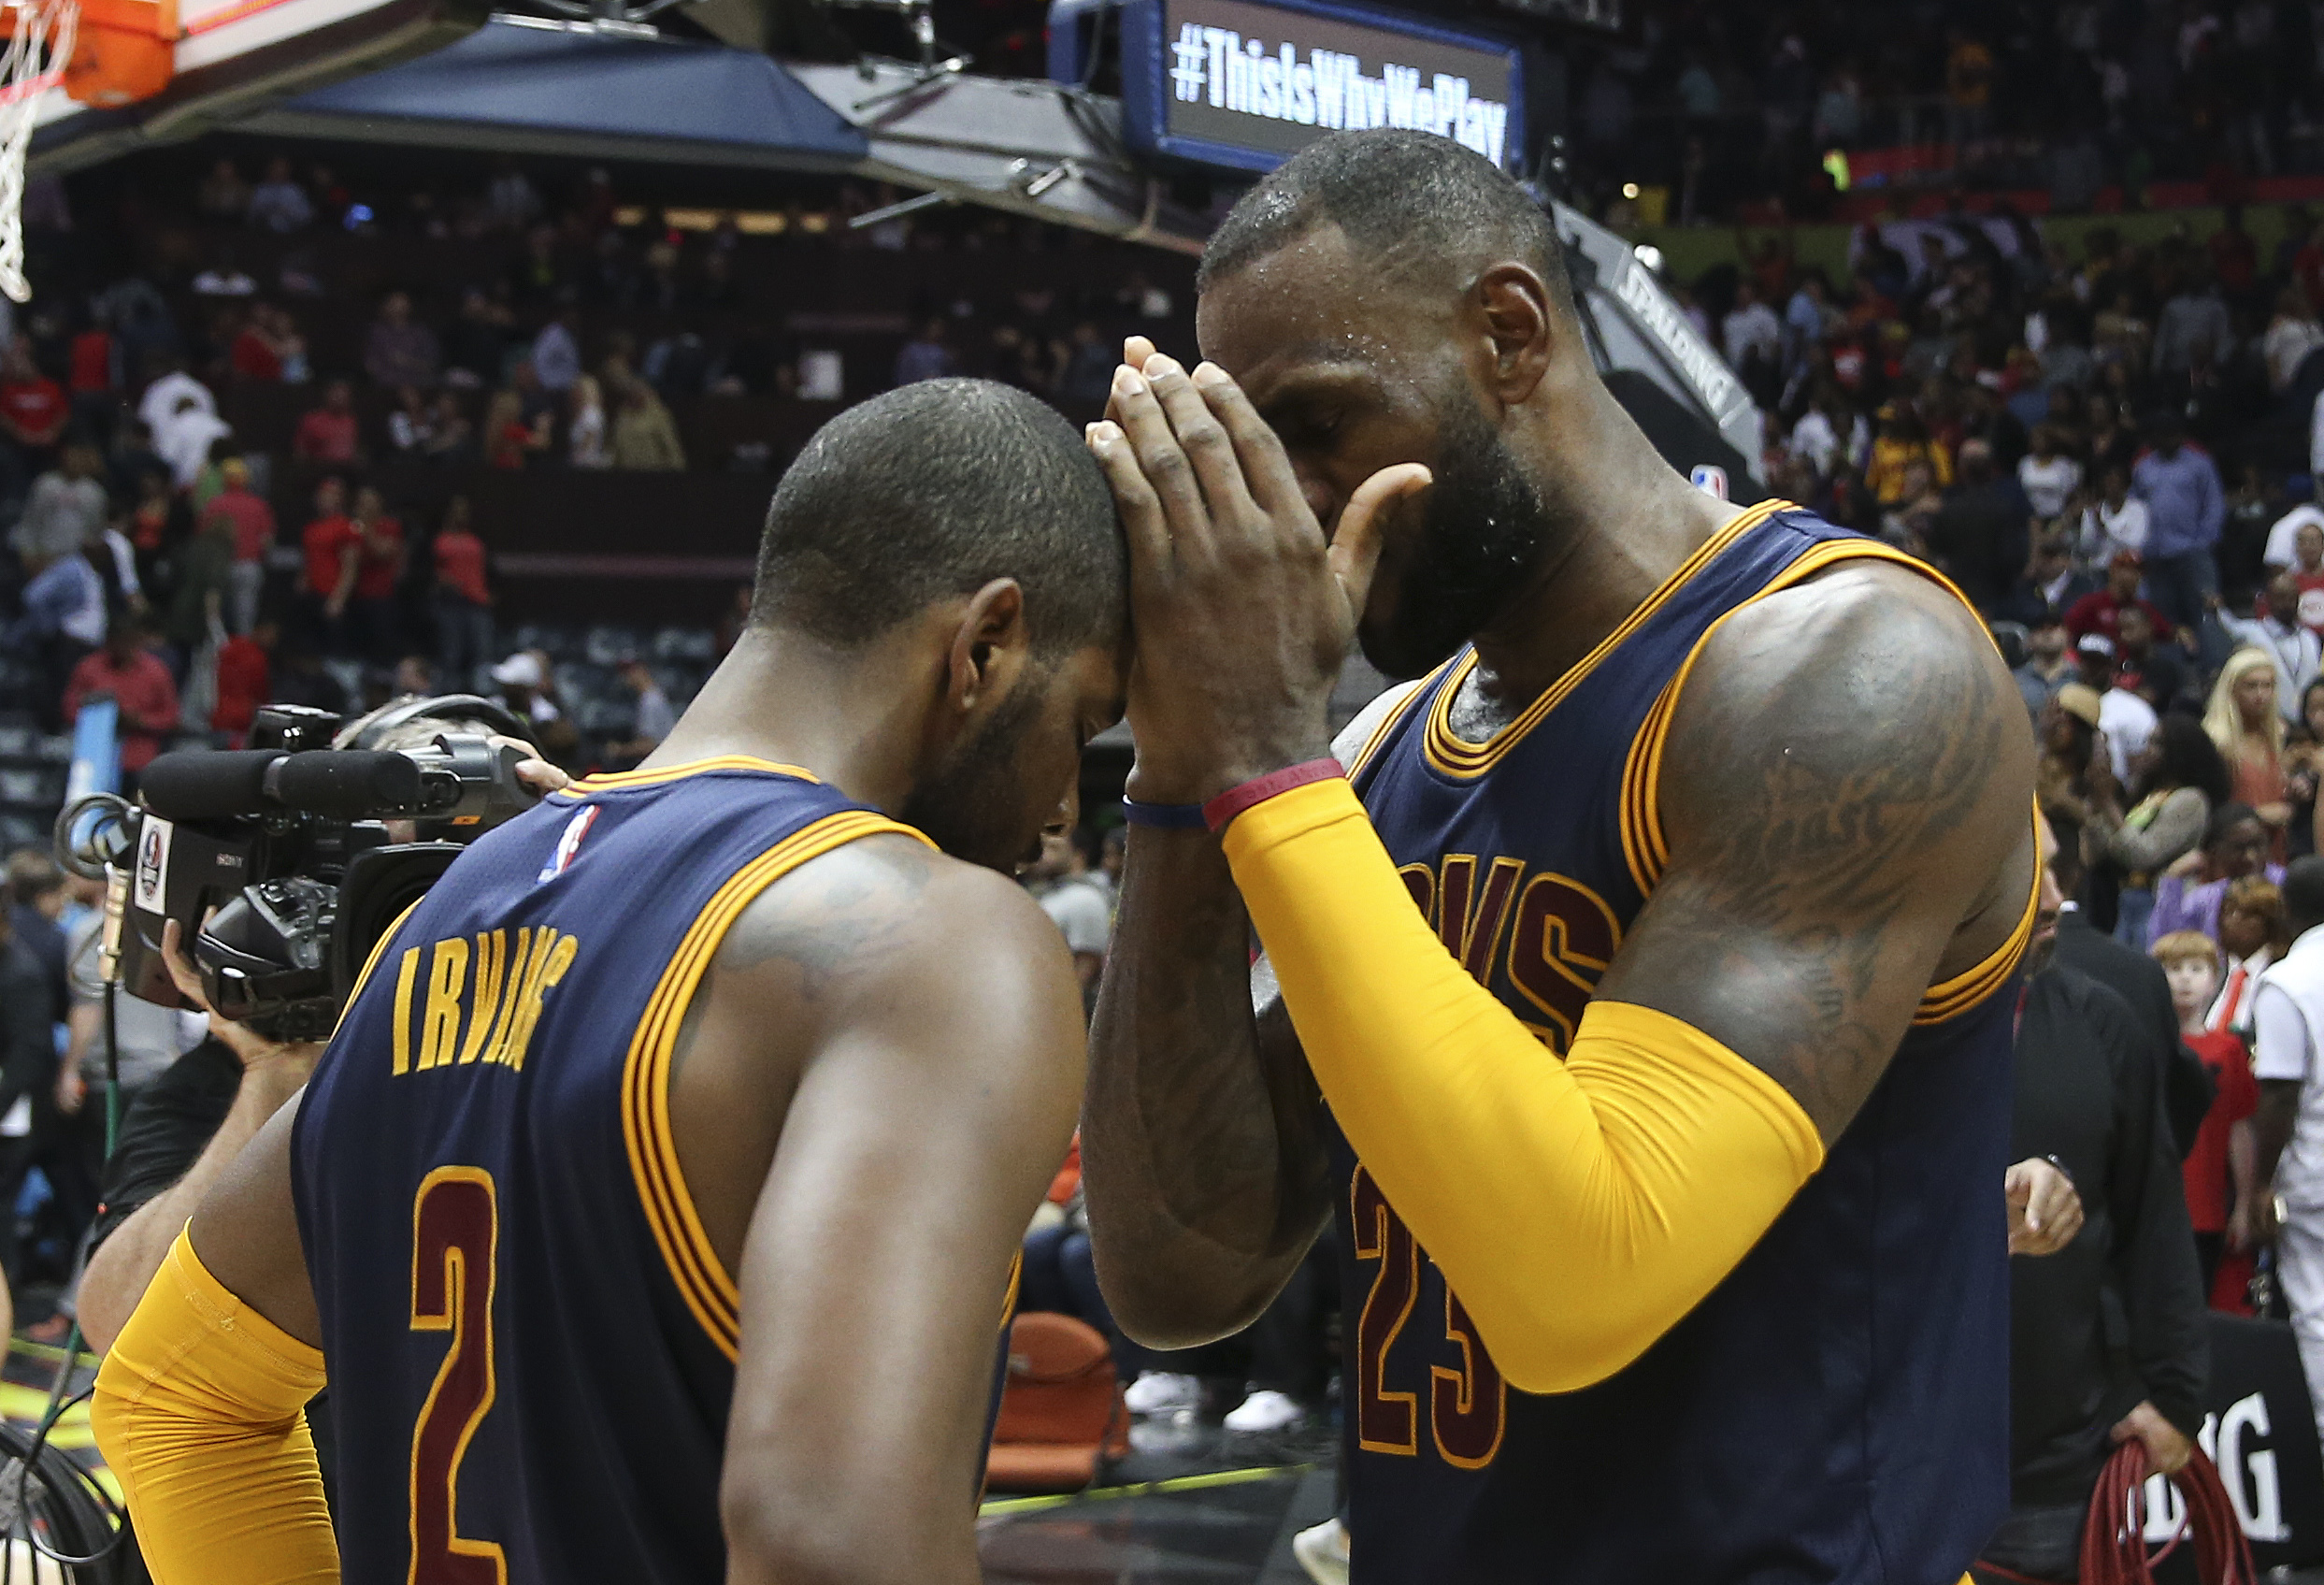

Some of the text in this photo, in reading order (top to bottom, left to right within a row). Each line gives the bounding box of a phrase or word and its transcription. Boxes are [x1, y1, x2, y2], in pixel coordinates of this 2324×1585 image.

[1169, 22, 1509, 169] #ThisIsWhyWePlay
[1618, 263, 1735, 413] SPALDING
[408, 1165, 508, 1585] 2
